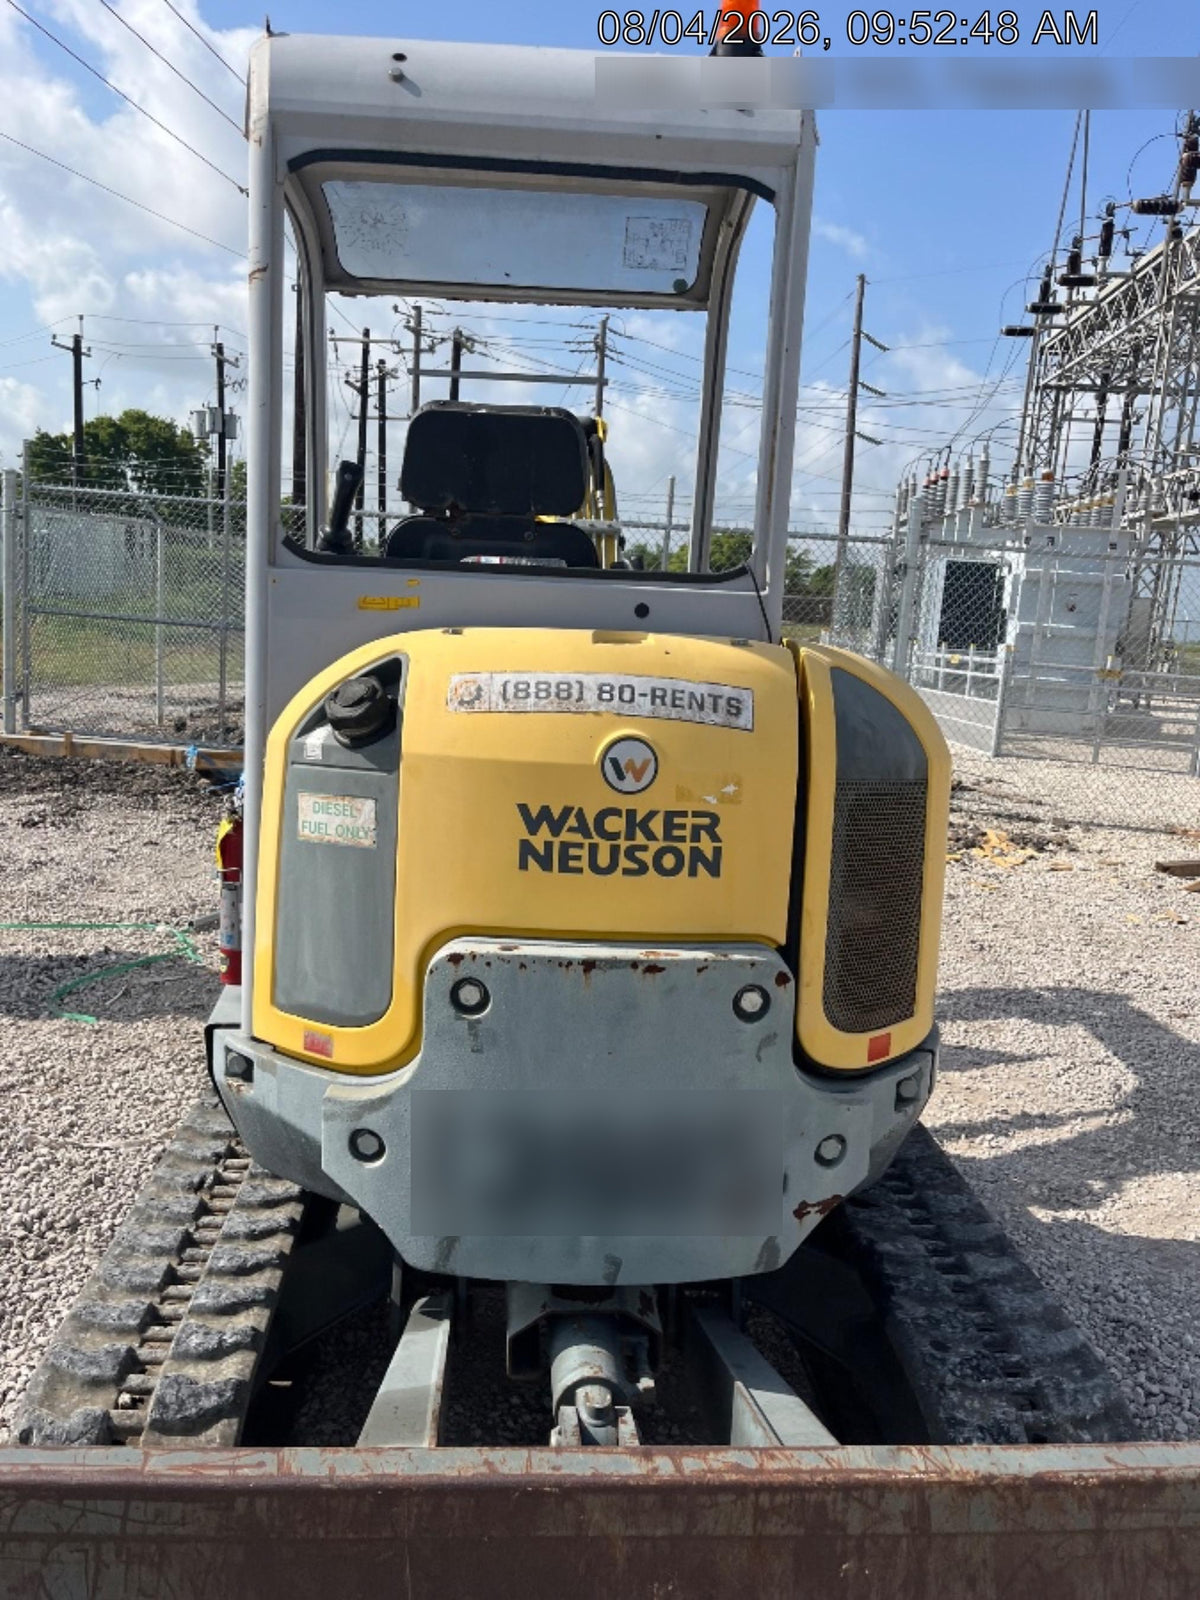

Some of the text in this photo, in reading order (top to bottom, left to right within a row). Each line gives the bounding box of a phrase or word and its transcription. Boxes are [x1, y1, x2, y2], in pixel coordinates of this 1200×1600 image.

[501, 680, 743, 717] (888) 80-RENTS
[312, 801, 357, 818] DIESEL
[516, 803, 723, 843] WACKER
[301, 821, 332, 836] FUEL
[518, 839, 723, 878] NEUSON
